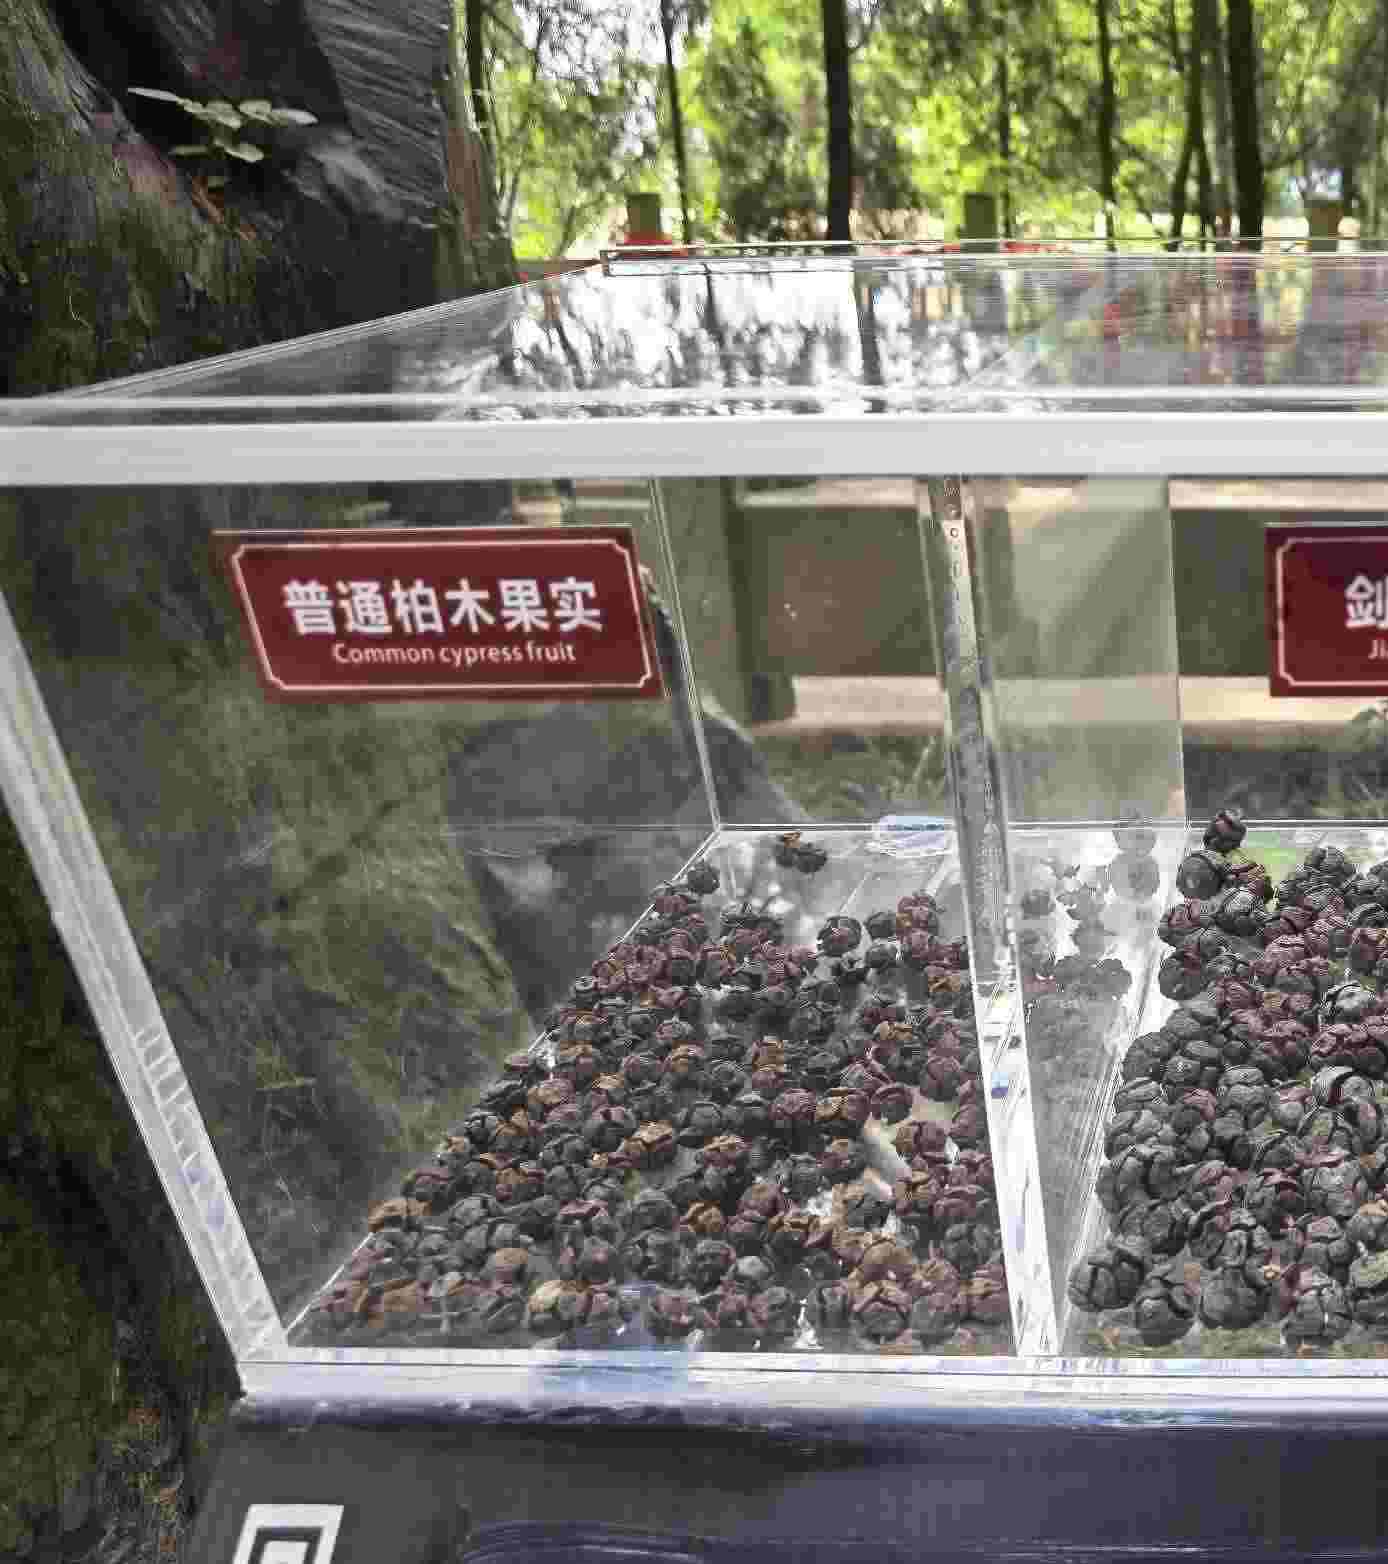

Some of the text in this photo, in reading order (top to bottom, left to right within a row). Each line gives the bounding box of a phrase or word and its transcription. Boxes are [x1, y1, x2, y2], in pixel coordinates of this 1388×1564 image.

[281, 577, 603, 636] 普通柏木果实
[332, 639, 576, 667] Common cypress fruit
